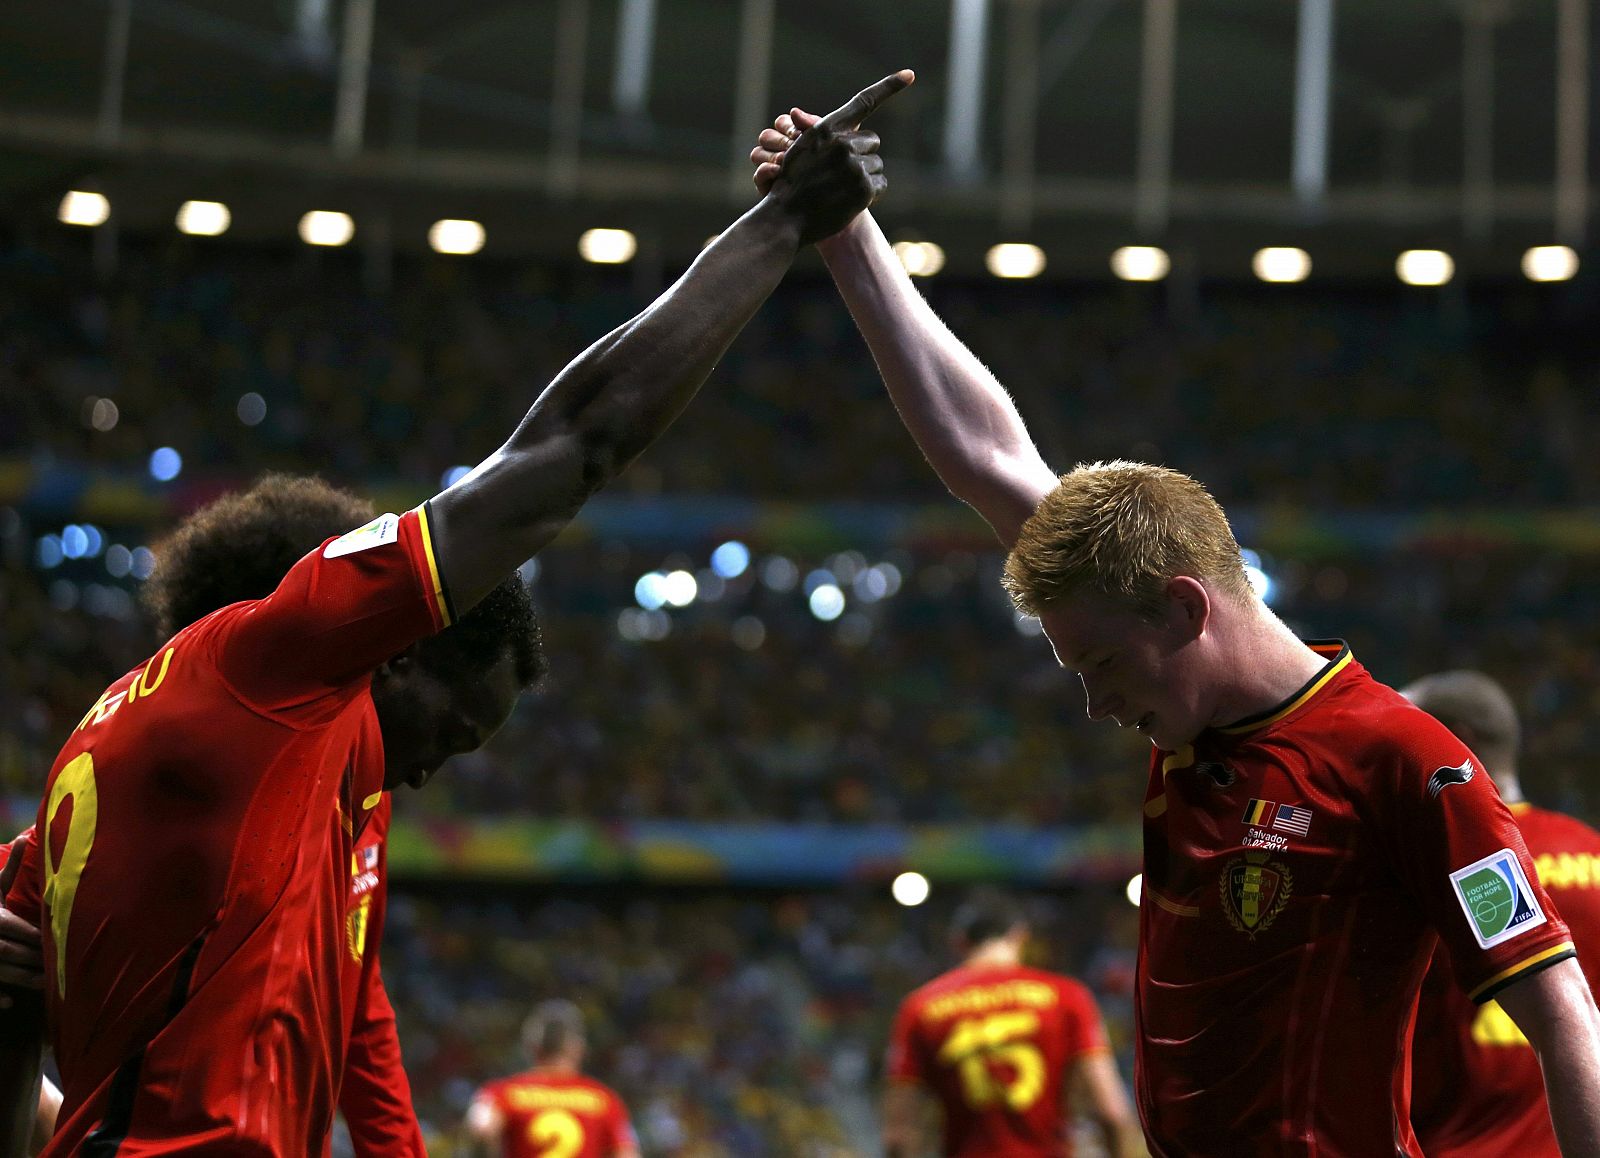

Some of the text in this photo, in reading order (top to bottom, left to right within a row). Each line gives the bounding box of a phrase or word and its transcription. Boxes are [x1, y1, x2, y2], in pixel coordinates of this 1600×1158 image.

[1248, 828, 1288, 844] Salvador
[43, 751, 98, 1001] 9
[1466, 877, 1501, 897] FOOTBALL
[1469, 884, 1503, 904] FOR HOPE
[1514, 911, 1533, 923] FIFA
[938, 1011, 1046, 1111] 15
[528, 1109, 584, 1158] 2
